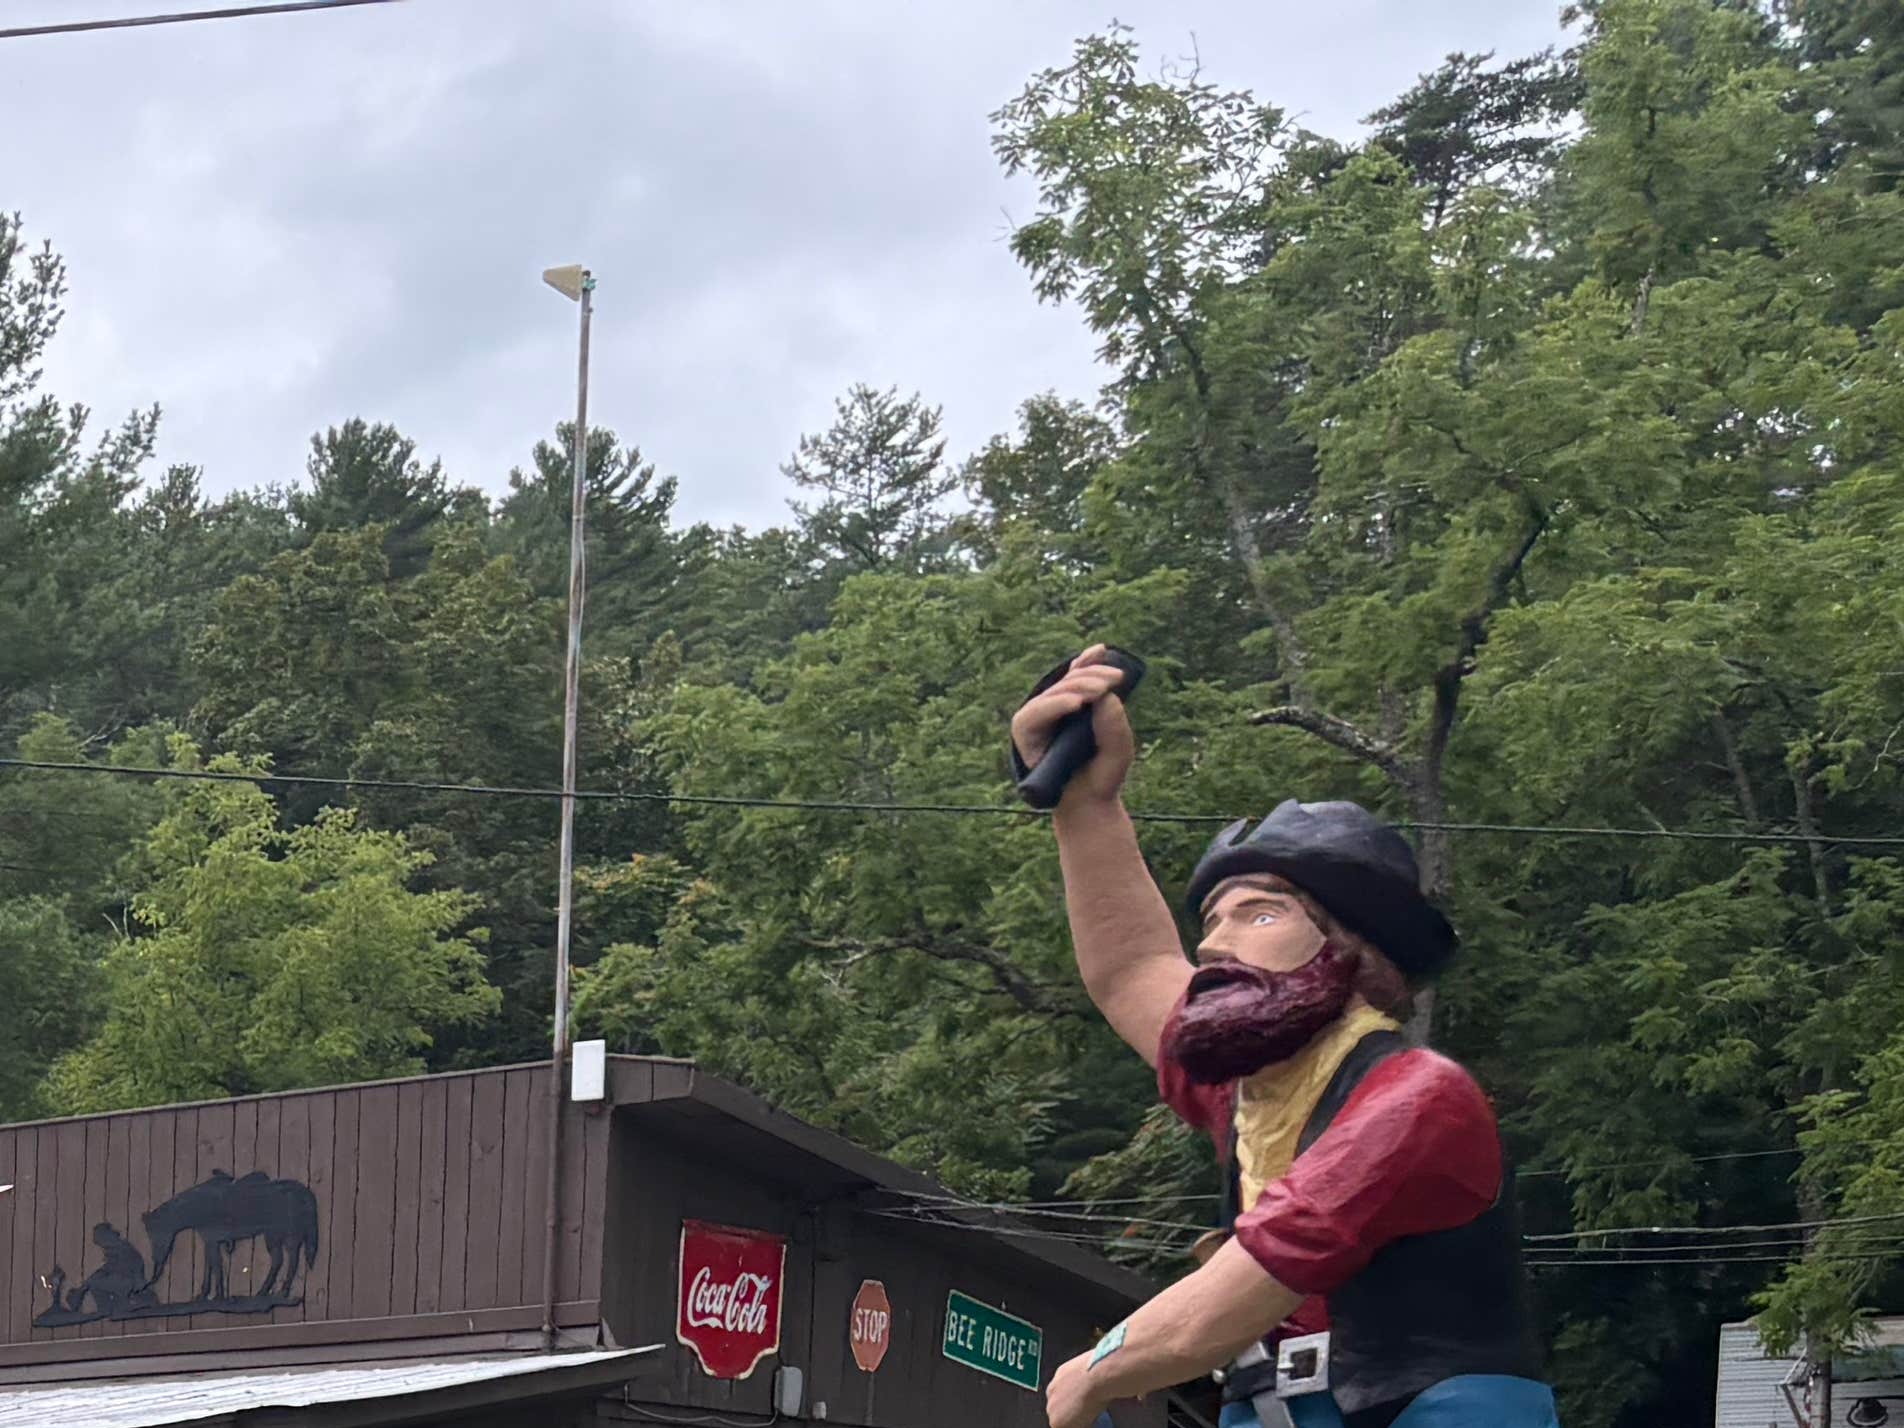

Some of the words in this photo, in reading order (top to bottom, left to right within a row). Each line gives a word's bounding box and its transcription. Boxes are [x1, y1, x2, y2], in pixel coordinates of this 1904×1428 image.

[687, 1266, 772, 1335] Coca-Cola
[854, 1308, 888, 1344] STOP
[947, 1311, 976, 1351] BEE
[981, 1326, 1026, 1371] RIDGE
